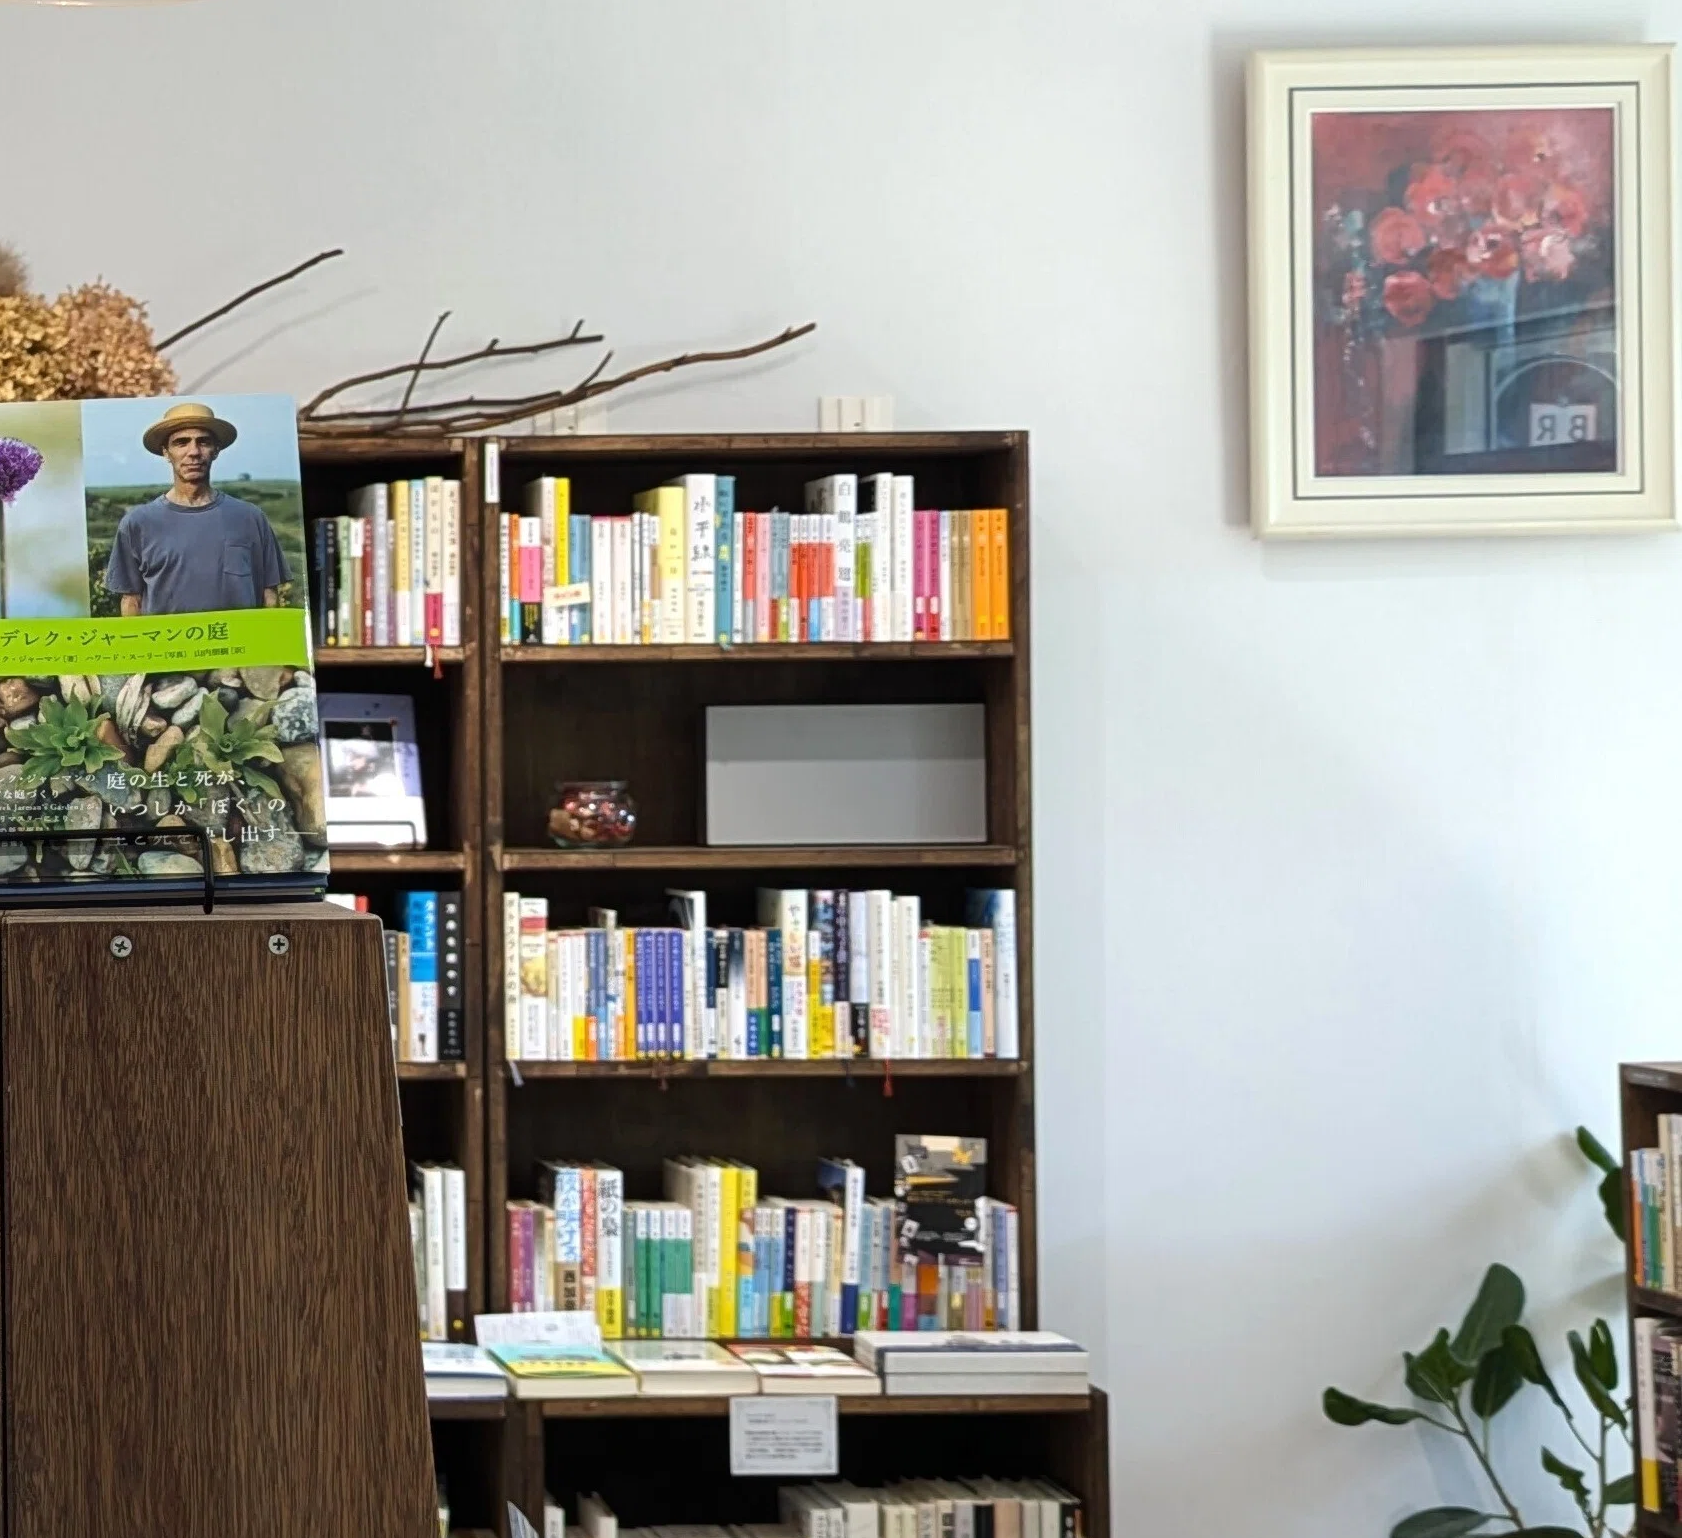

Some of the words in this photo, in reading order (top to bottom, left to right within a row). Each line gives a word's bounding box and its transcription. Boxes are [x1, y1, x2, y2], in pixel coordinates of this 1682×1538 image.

[0, 622, 230, 649] デレク・ジャーマンの庭
[106, 769, 248, 790] 庭の生と死が、
[108, 797, 287, 817] いつしか「ぼく」の
